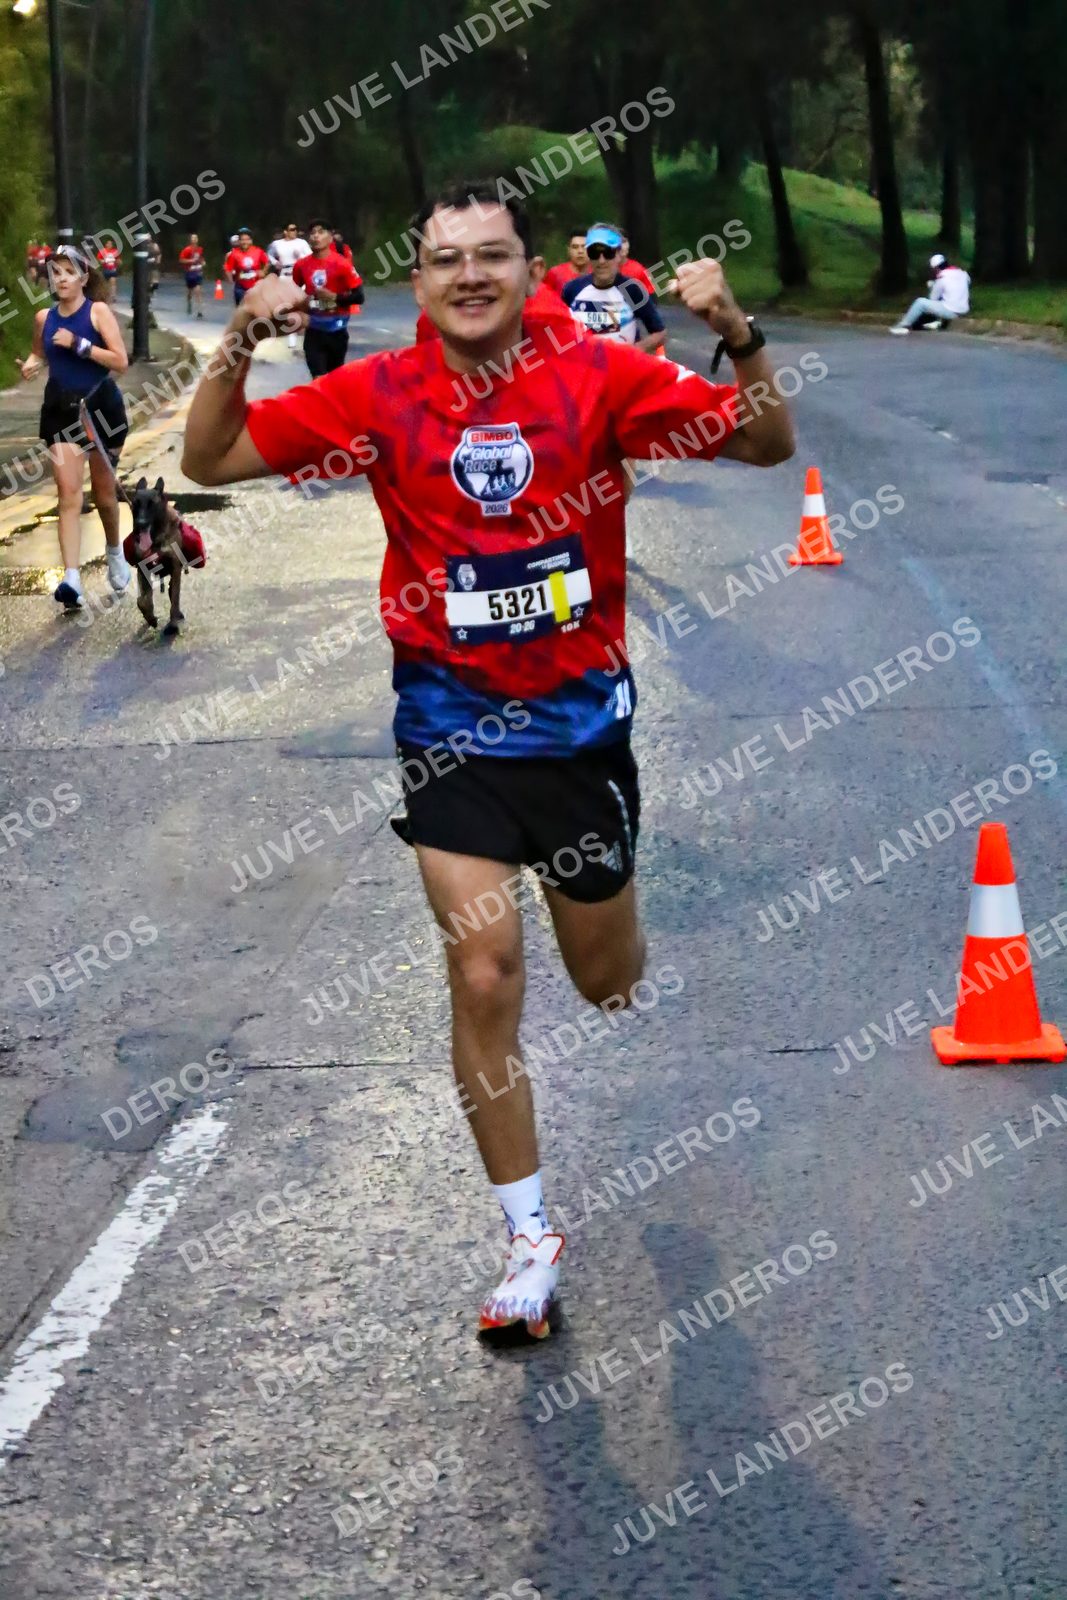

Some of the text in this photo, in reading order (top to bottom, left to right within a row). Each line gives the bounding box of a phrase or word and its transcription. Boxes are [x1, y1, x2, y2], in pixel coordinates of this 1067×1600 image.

[471, 431, 513, 442] BIMBO
[472, 445, 513, 460] Global
[464, 460, 497, 473] Race
[485, 504, 508, 513] 2026
[488, 584, 547, 621] 5321
[561, 620, 580, 633] 10K
